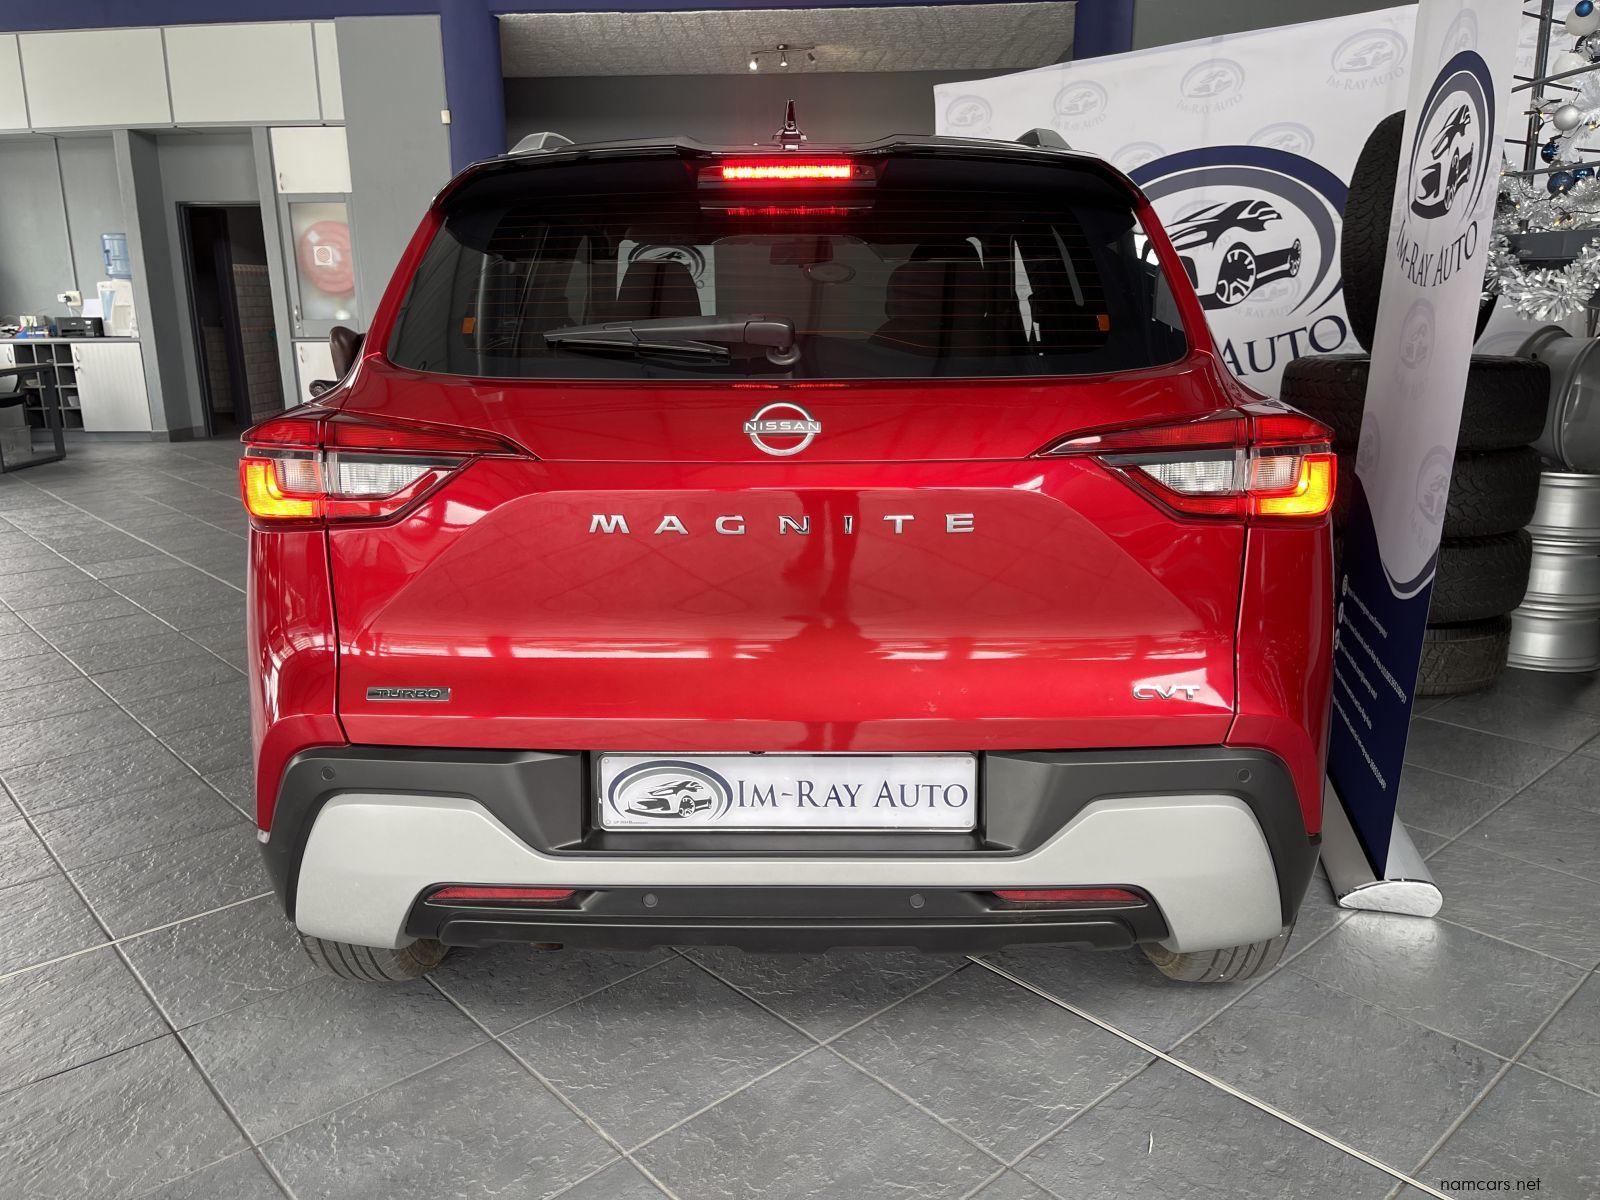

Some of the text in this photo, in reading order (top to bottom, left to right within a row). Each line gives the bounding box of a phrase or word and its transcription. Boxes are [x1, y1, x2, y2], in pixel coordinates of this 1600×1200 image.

[1432, 220, 1478, 287] AUTO
[1222, 314, 1348, 376] AUTO
[745, 420, 820, 432] NISSAN
[588, 512, 976, 535] MAGNITE
[376, 688, 442, 699] TURBO
[1132, 684, 1201, 701] CVT
